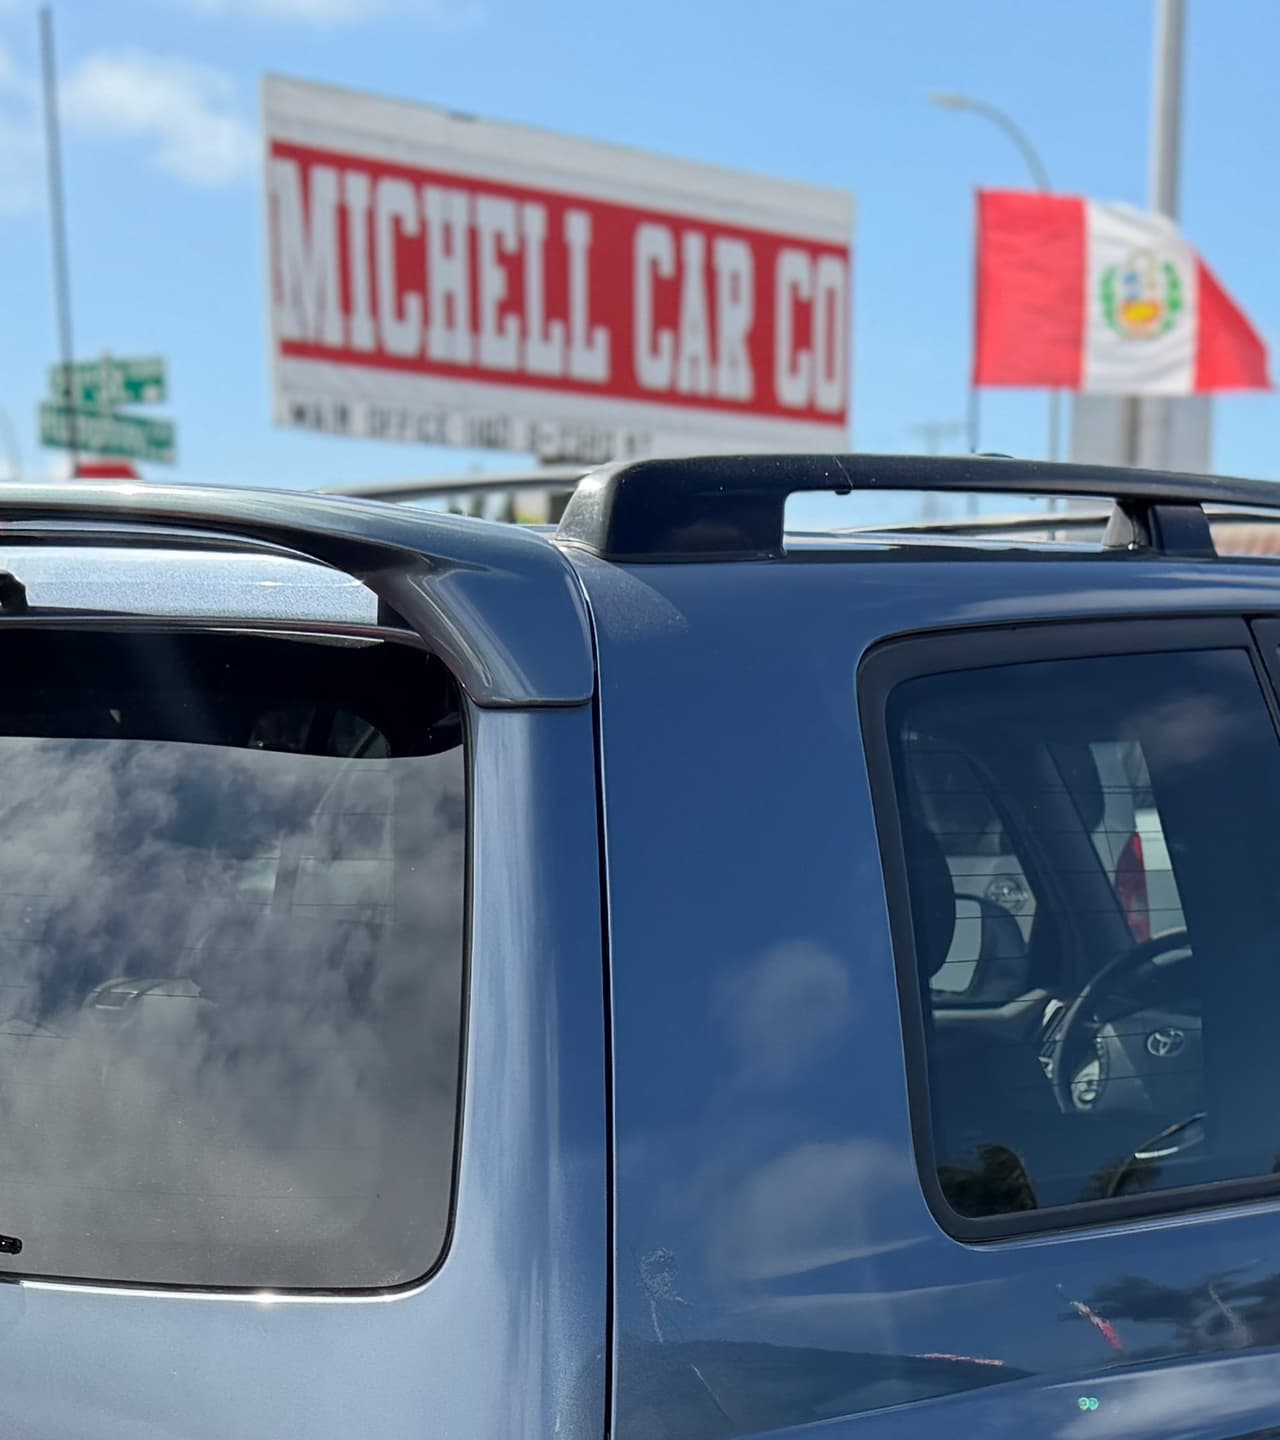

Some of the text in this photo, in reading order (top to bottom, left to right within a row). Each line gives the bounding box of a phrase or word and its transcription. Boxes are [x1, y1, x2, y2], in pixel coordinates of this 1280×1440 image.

[270, 157, 846, 414] MICHELL CAR CO
